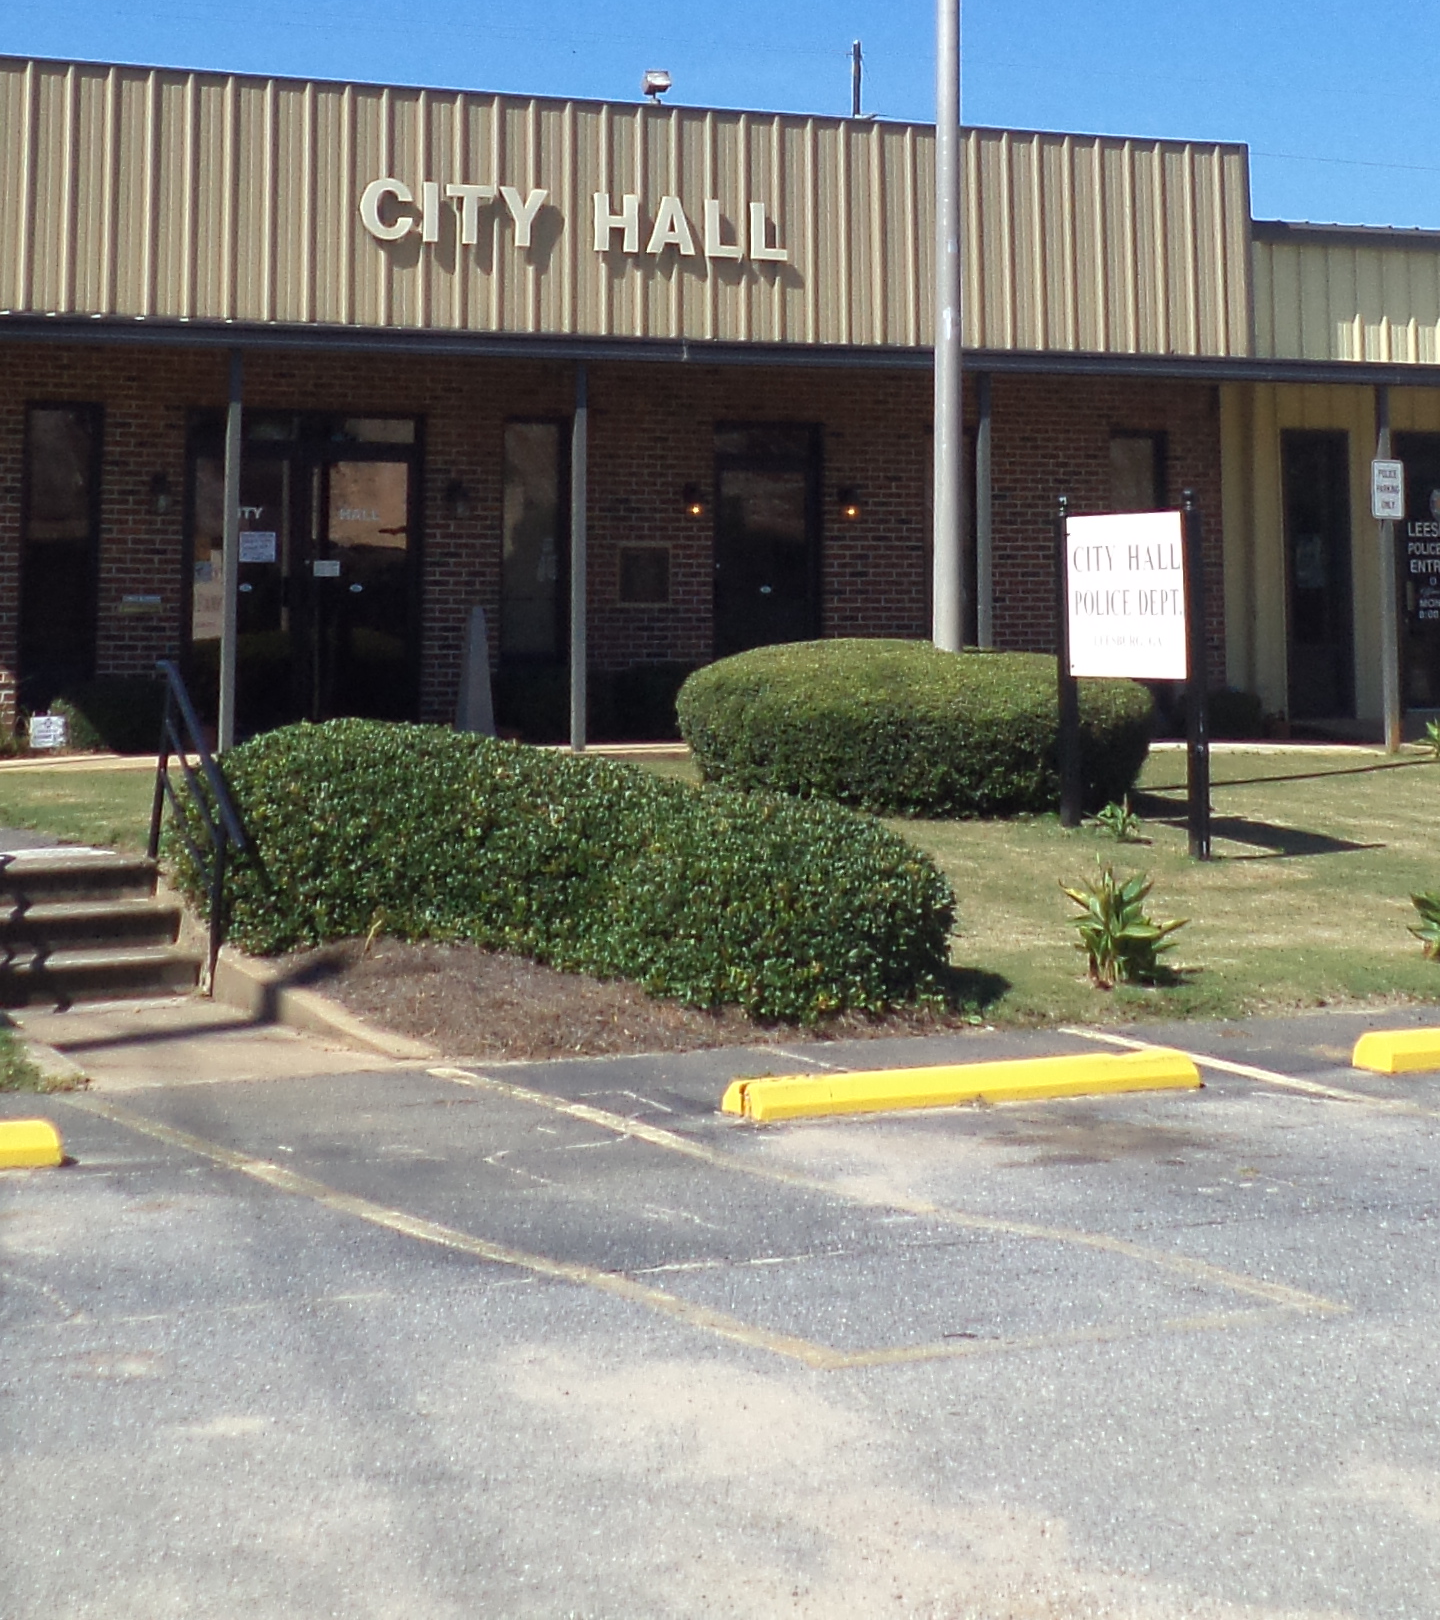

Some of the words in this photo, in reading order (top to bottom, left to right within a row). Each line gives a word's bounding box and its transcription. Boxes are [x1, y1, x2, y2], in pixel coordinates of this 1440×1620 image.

[359, 177, 548, 248] CITY
[592, 192, 788, 262] HALL
[339, 508, 381, 521] HALL
[1073, 545, 1116, 573] CITY
[1128, 542, 1181, 571] HALL
[1075, 589, 1132, 616] POLICE
[1138, 589, 1183, 616] DEPT.
